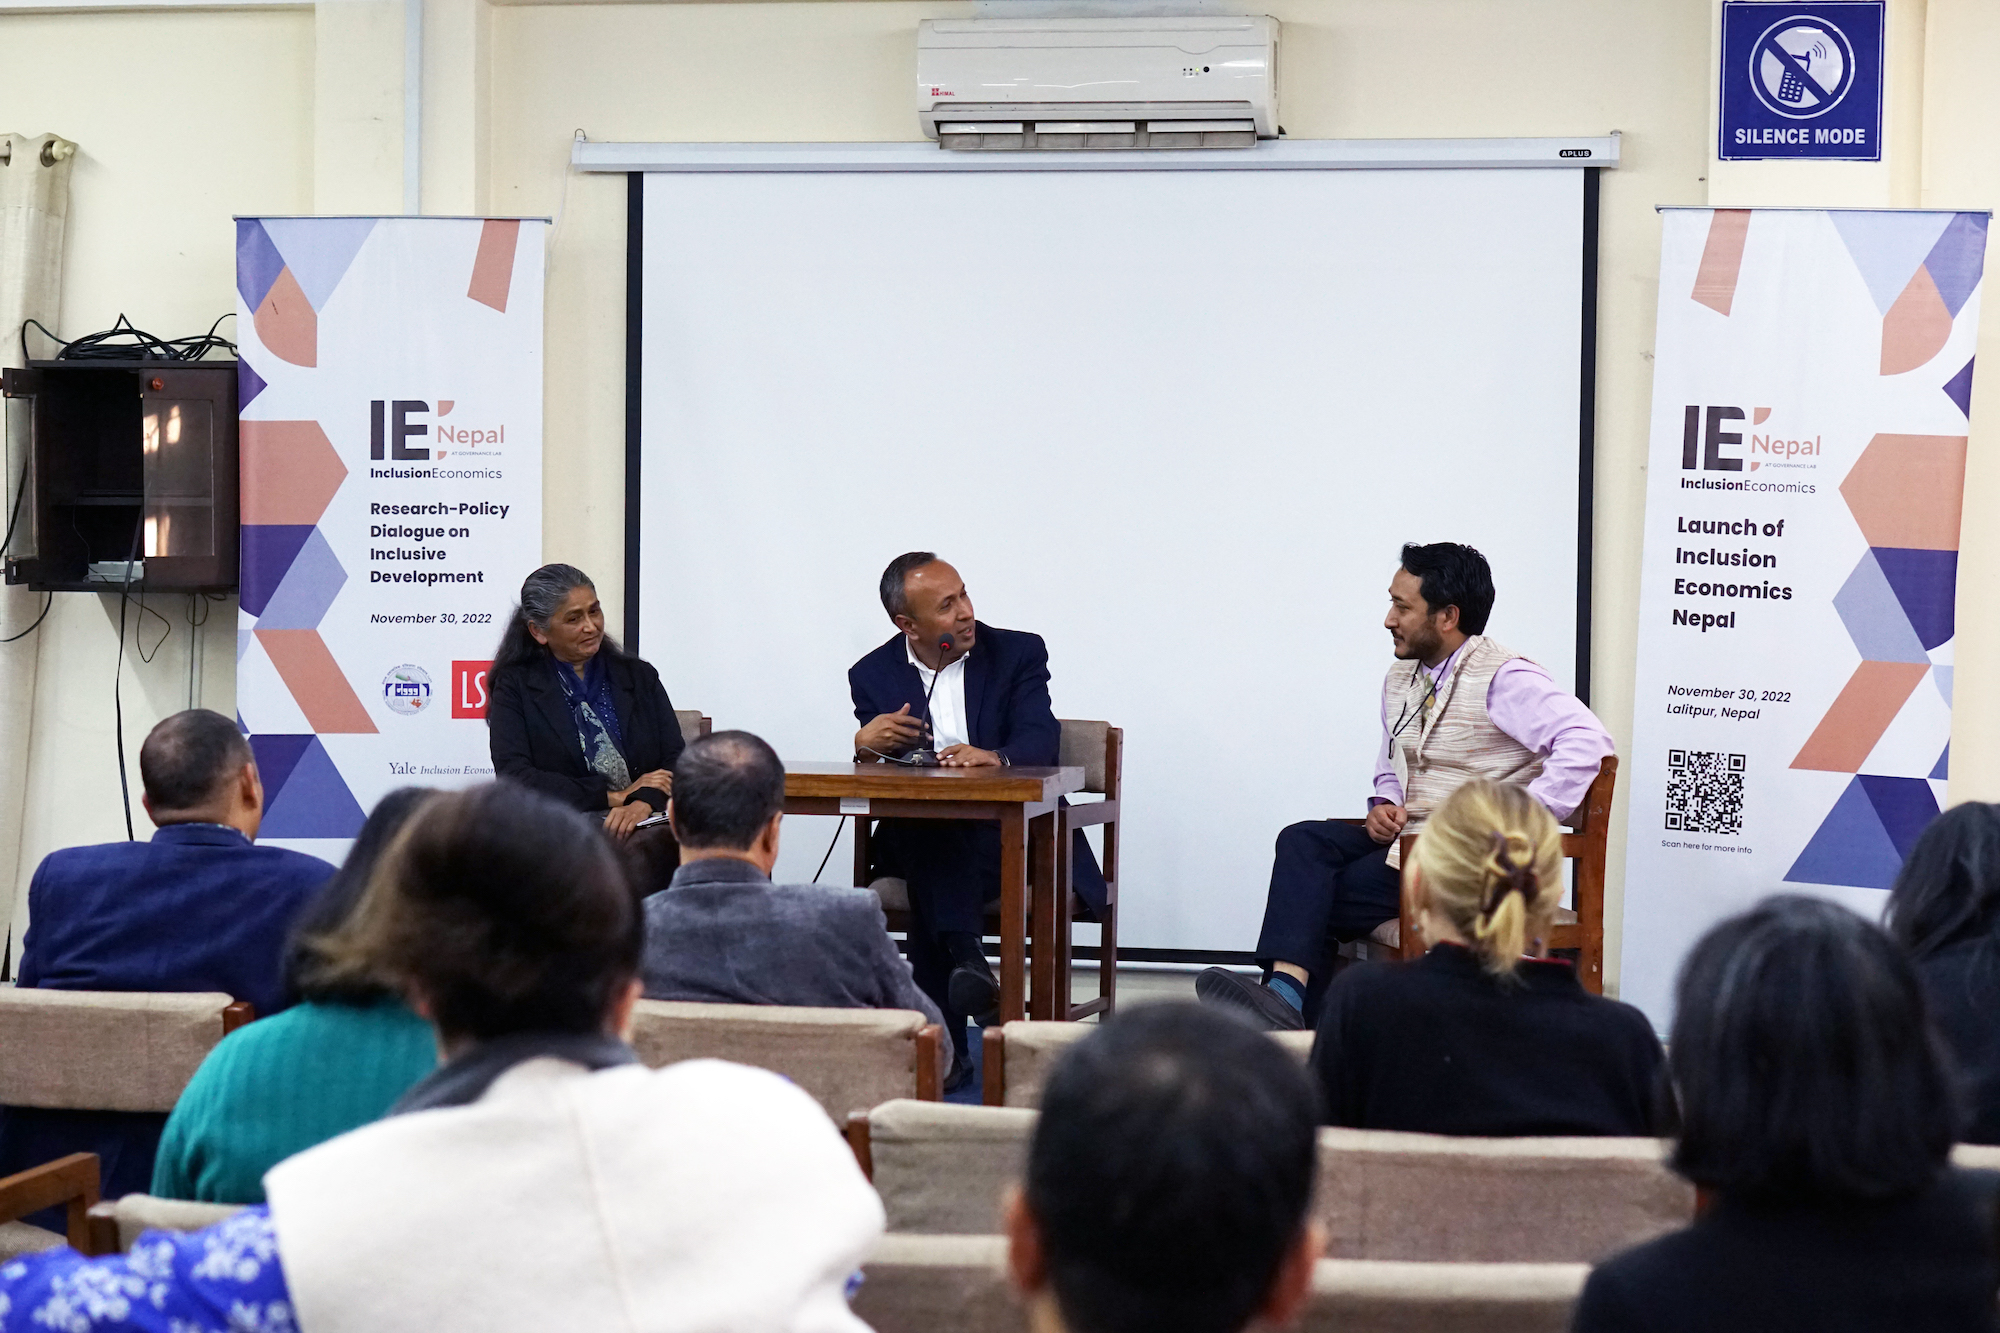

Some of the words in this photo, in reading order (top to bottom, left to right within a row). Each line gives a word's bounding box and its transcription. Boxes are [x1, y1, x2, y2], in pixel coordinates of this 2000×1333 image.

[1735, 128, 1809, 144] SILENCE
[1815, 128, 1865, 144] MODE
[370, 400, 430, 460] IE
[437, 424, 504, 448] Nepal
[1682, 405, 1745, 471] IE
[1751, 434, 1821, 460] Nepal
[370, 467, 503, 479] InclusionEconomics
[1681, 477, 1816, 494] InclusionEconomics
[370, 501, 510, 519] Research-Policy
[370, 523, 445, 542] Dialogue
[448, 527, 470, 538] on
[1677, 516, 1757, 536] Launch
[1762, 519, 1785, 537] of
[370, 546, 447, 560] Inclusive
[1676, 547, 1777, 568] Inclusion
[370, 570, 484, 587] Development
[1674, 578, 1793, 601] Economics
[370, 613, 437, 624] November
[439, 613, 458, 625] 30,
[461, 613, 492, 624] 2022
[1672, 608, 1736, 633] Nepal
[1667, 685, 1735, 699] November
[1738, 689, 1757, 702] 30,
[1760, 691, 1792, 703] 2022
[1666, 703, 1717, 719] Lalitpur,
[1721, 706, 1761, 721] Nepal
[389, 762, 417, 775] Yale
[420, 765, 461, 775] Inclusion
[1661, 840, 1682, 848] Scan
[1682, 842, 1701, 850] here
[1701, 843, 1712, 851] for
[1713, 845, 1736, 853] more
[1736, 845, 1753, 854] info
